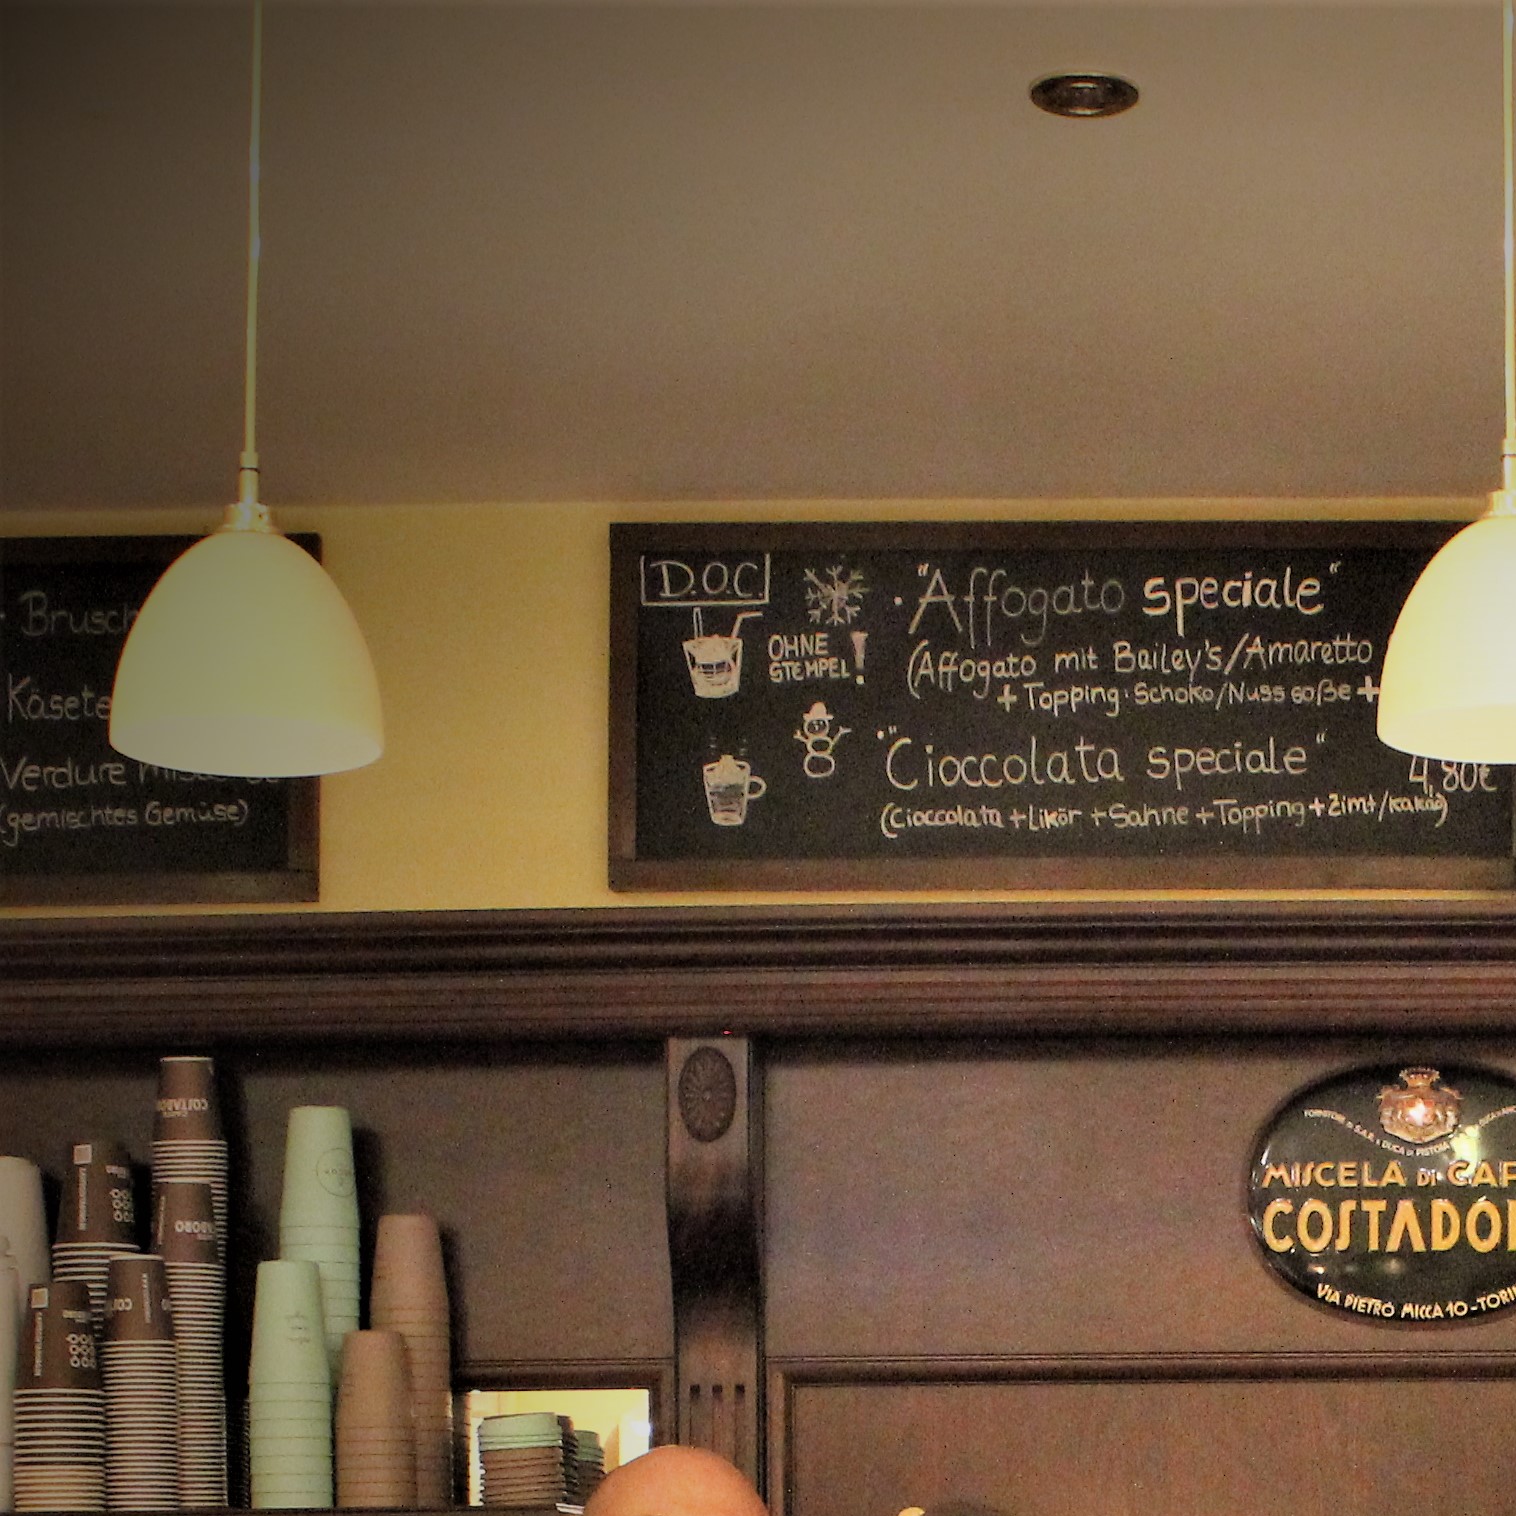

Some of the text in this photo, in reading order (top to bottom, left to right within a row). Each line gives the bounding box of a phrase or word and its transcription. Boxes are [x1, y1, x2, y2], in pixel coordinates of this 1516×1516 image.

[20, 590, 139, 637] Brusch
[768, 632, 829, 661] OHNE
[1054, 651, 1098, 674] mit
[7, 673, 112, 722] Käsete
[0, 757, 127, 792] Verdure
[1261, 1160, 1407, 1189] MISCELA
[1317, 1282, 1341, 1306] VIA
[1344, 1293, 1396, 1318] PIETRO
[1400, 1301, 1445, 1319] MICCA
